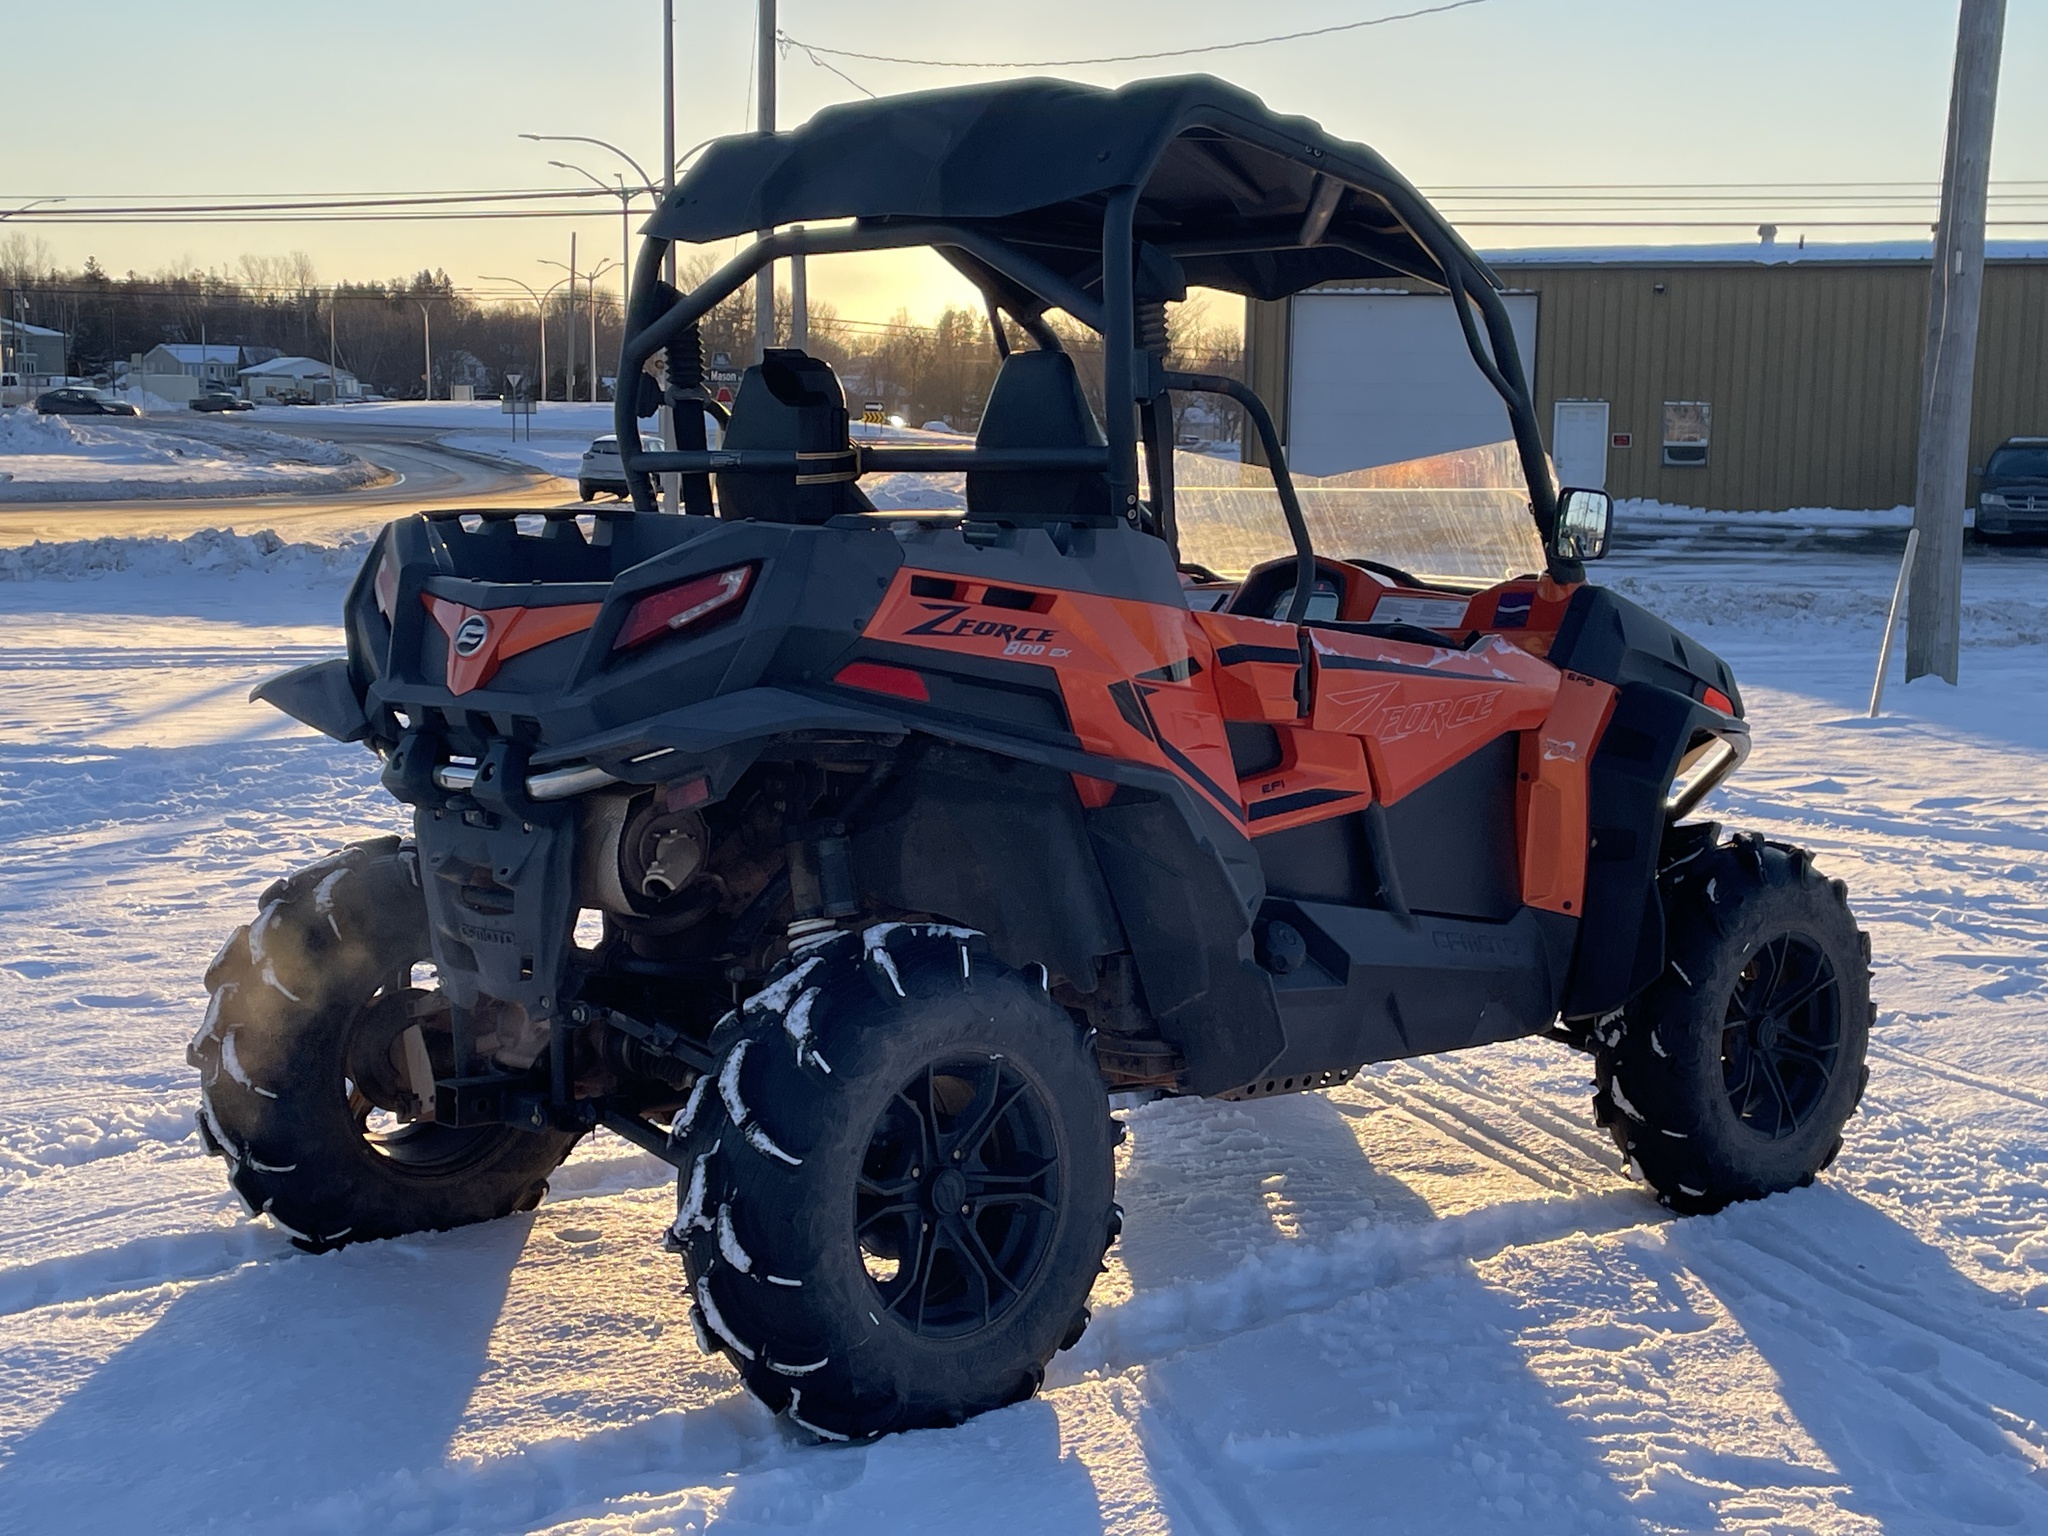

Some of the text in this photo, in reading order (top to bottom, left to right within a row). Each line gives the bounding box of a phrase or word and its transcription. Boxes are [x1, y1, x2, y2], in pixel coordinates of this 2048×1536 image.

[710, 370, 737, 382] Mason
[1003, 640, 1046, 656] 800
[1261, 779, 1285, 794] EFI
